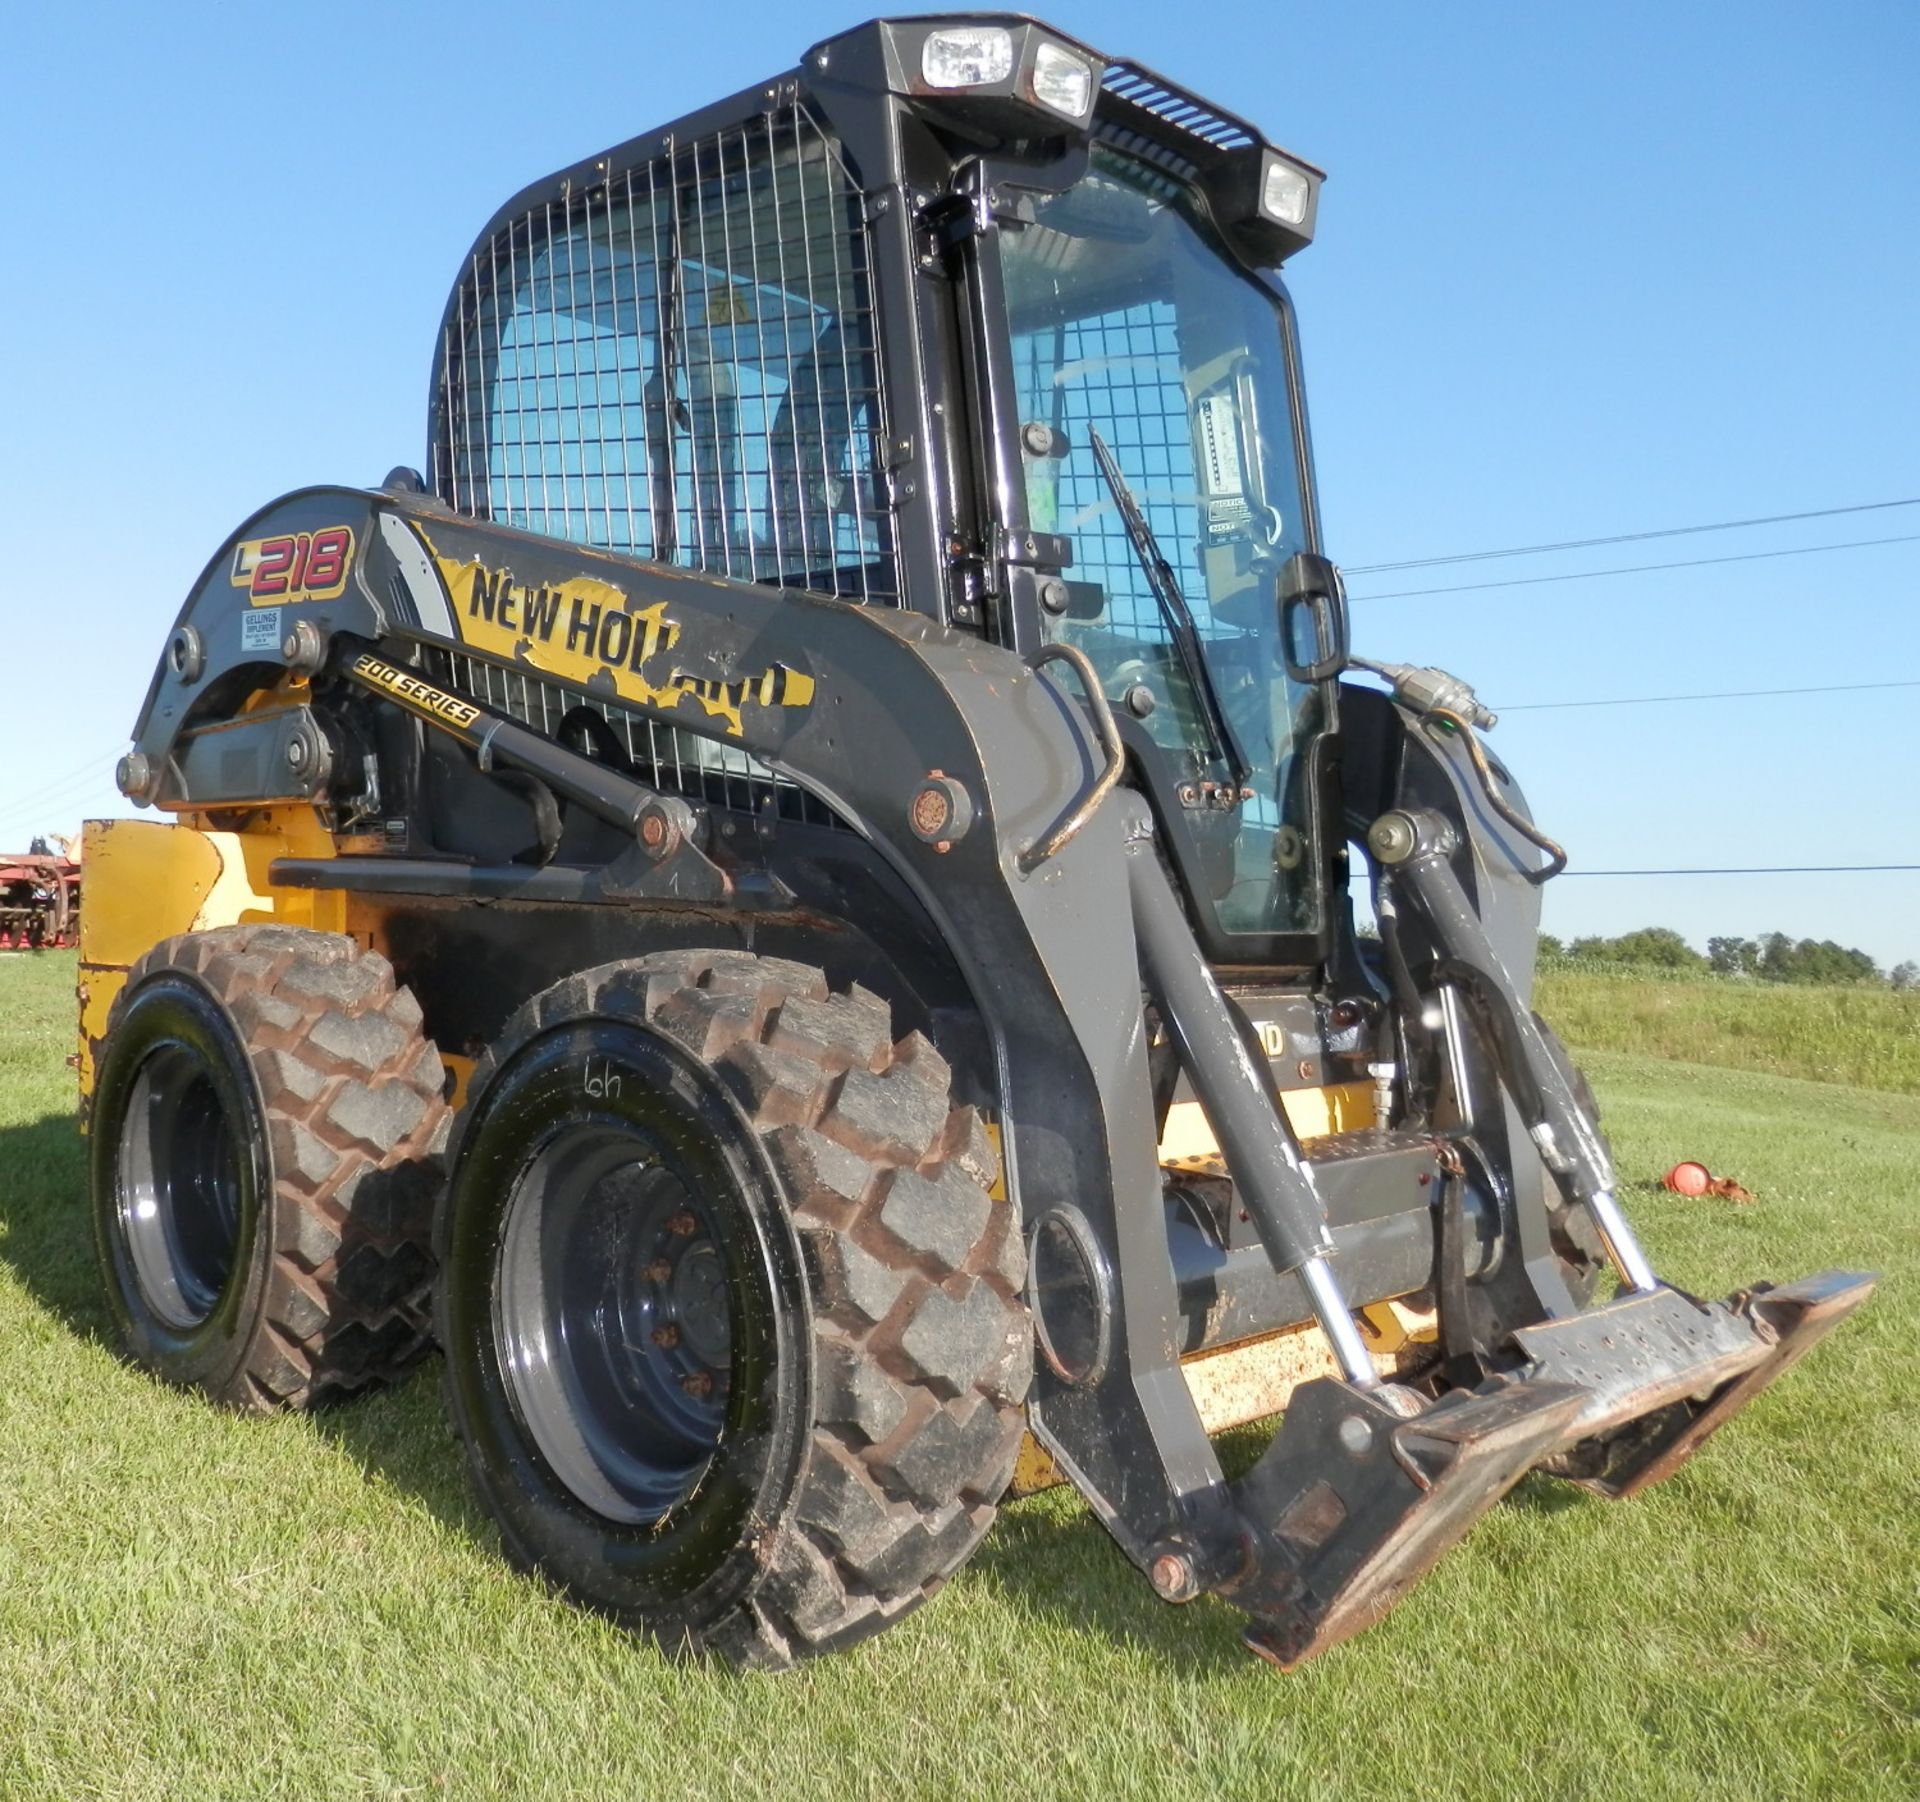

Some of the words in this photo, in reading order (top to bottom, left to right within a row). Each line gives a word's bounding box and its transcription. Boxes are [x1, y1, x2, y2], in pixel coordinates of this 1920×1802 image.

[230, 527, 353, 603] L218
[469, 567, 562, 642] NEW
[357, 656, 399, 684] 200
[397, 678, 477, 723] SERIES
